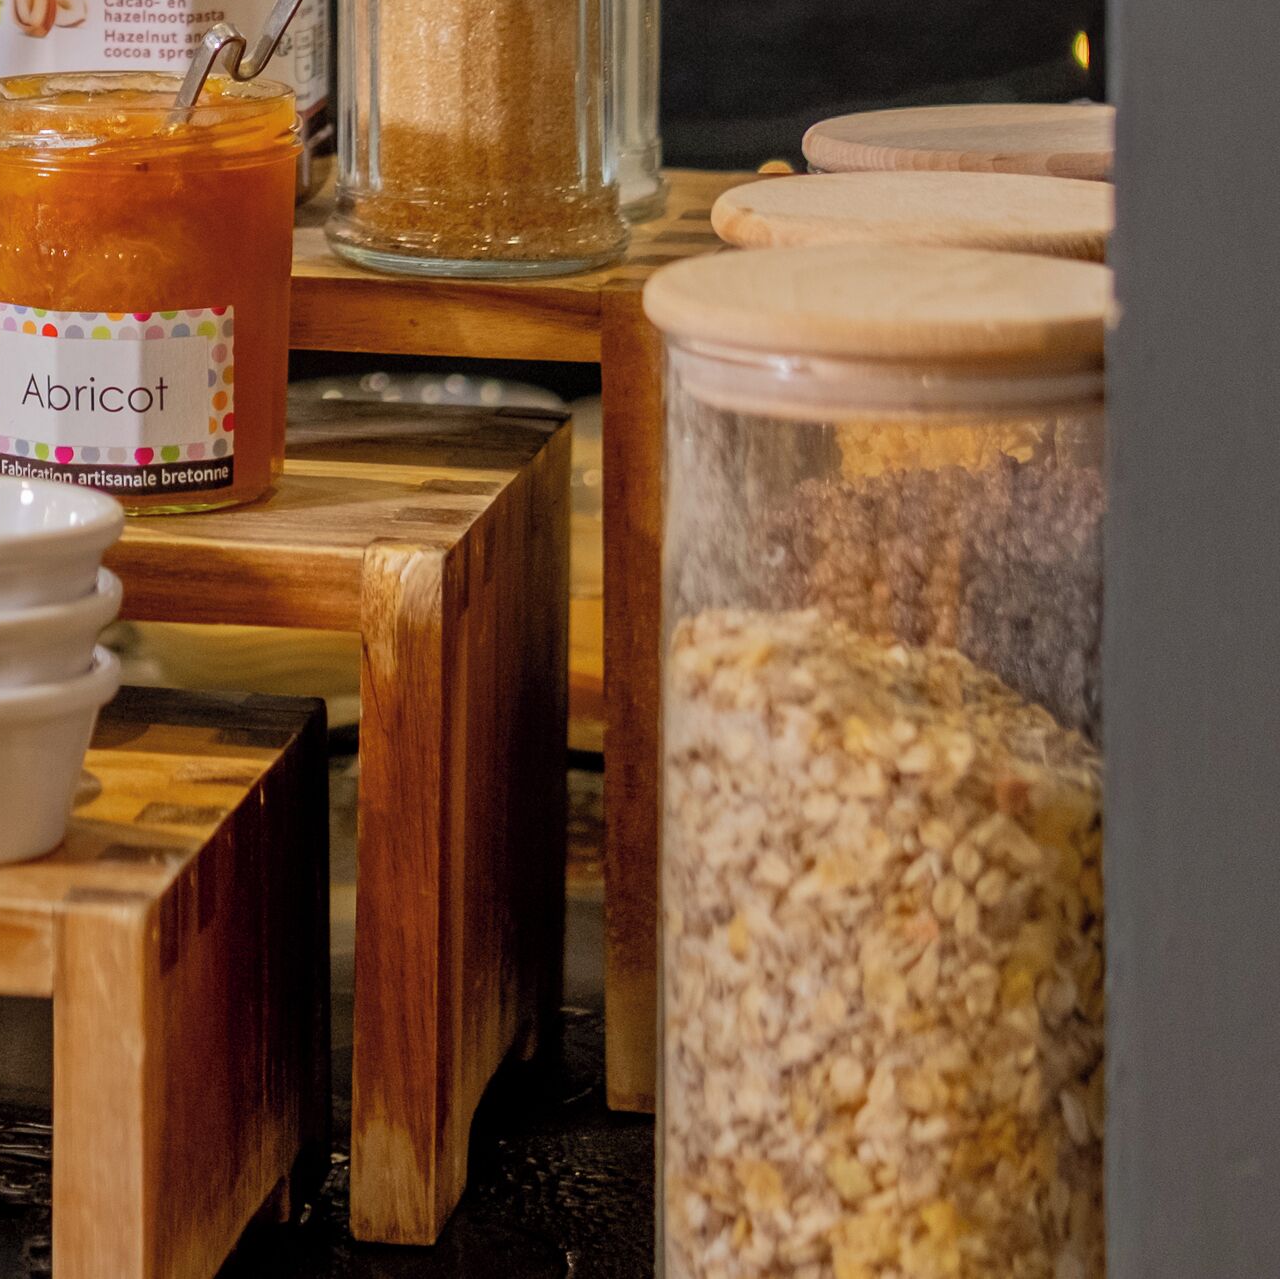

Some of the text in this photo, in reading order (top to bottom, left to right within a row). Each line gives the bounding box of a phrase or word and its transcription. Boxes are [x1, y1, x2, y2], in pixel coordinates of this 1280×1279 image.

[103, 10, 225, 28] hazelnootpasta
[103, 29, 203, 44] Hazelnut an
[103, 47, 195, 62] cocoa spre
[21, 373, 169, 414] Abricot
[78, 470, 157, 488] artisanale
[161, 465, 229, 486] bretonne
